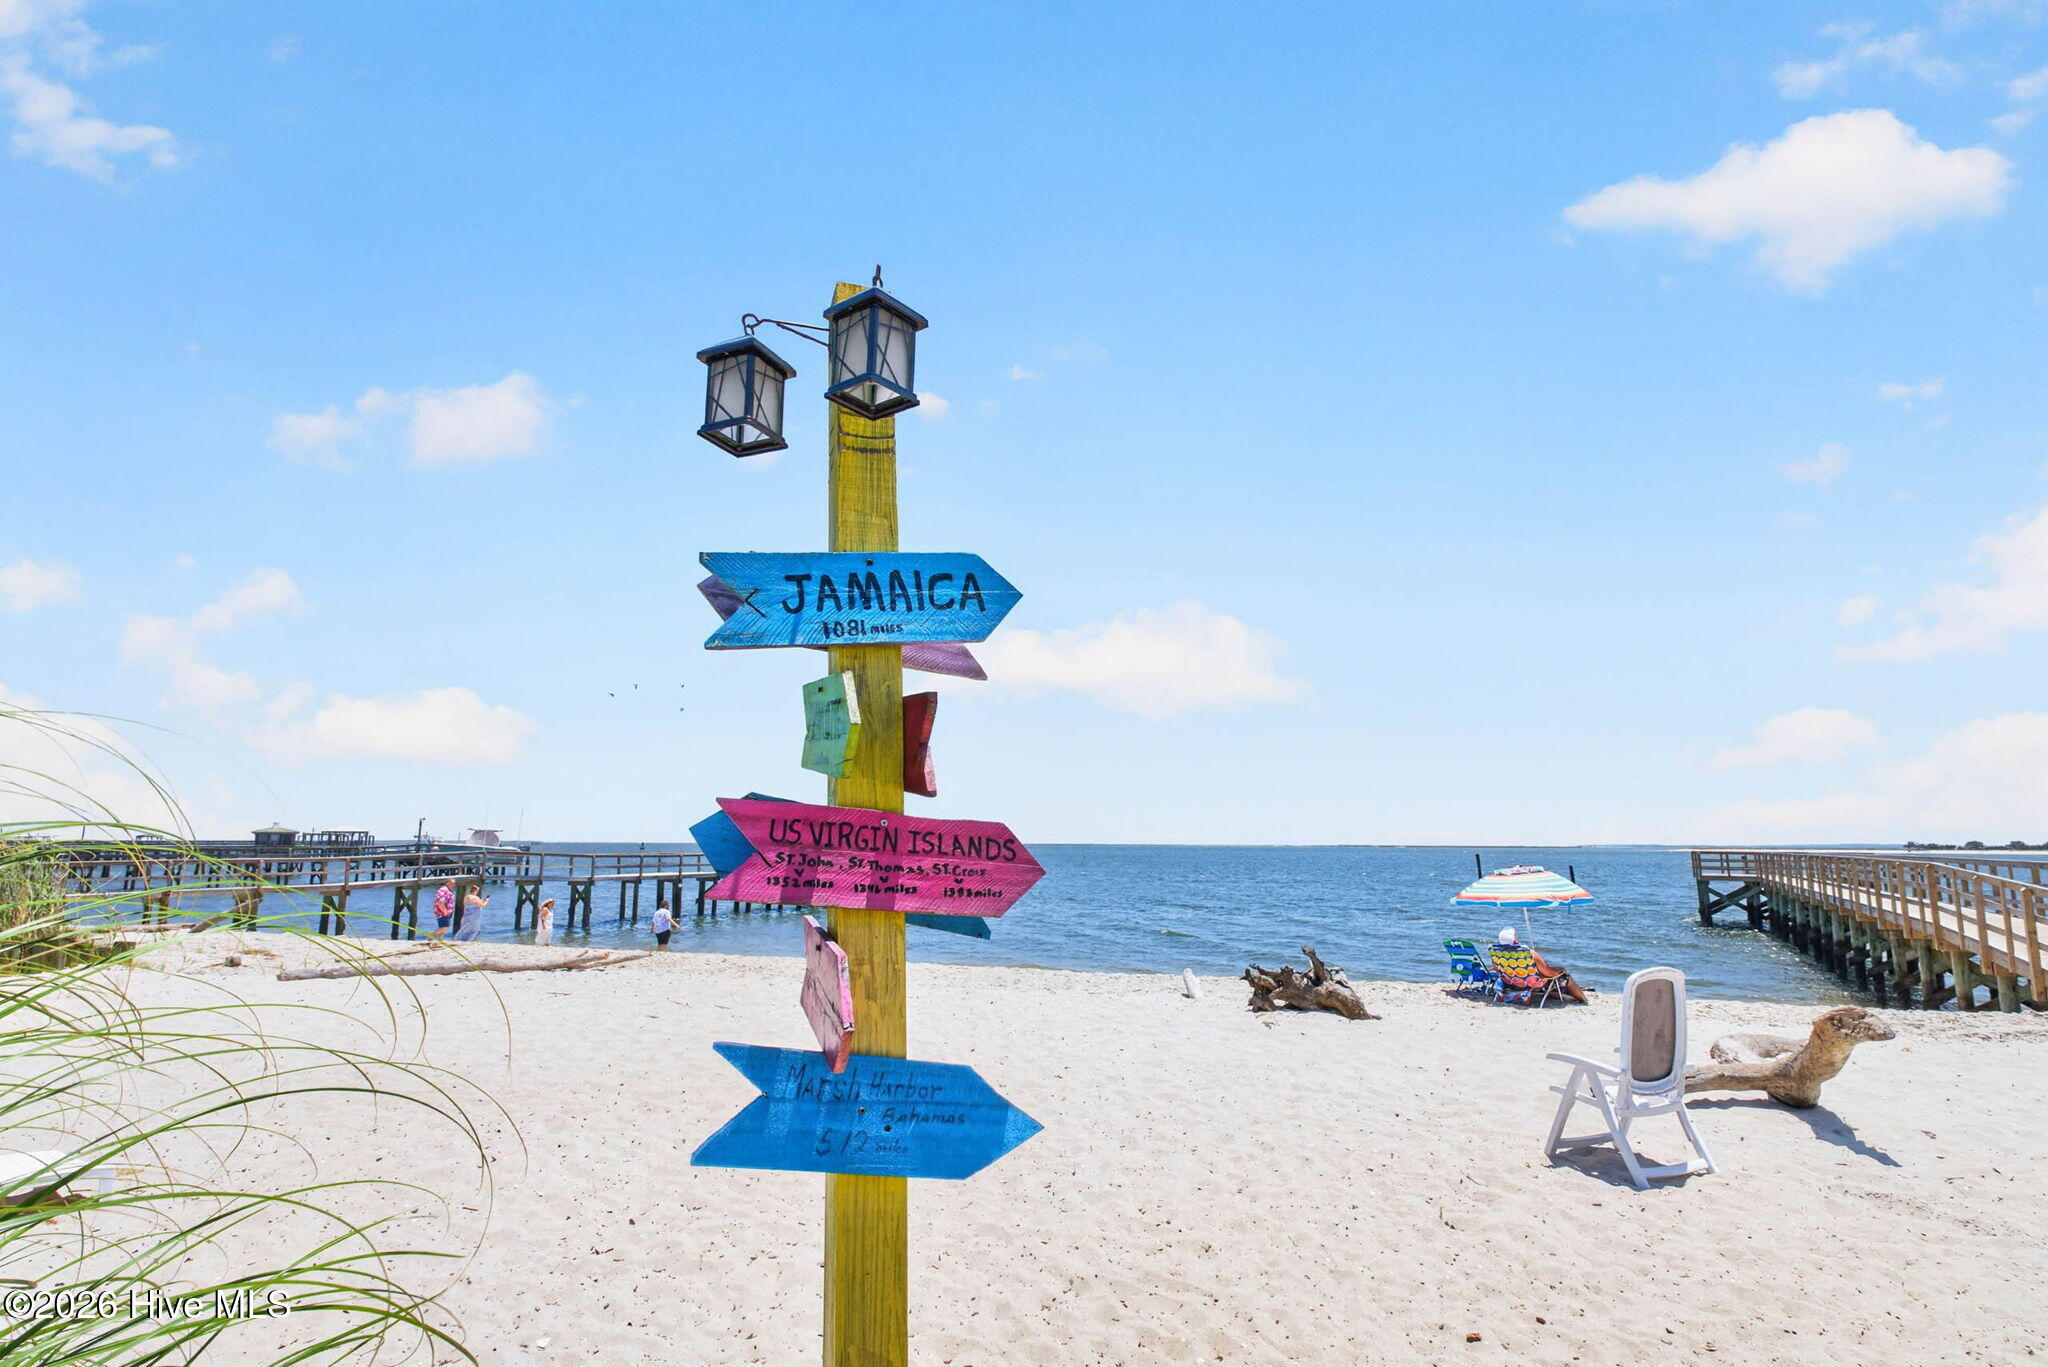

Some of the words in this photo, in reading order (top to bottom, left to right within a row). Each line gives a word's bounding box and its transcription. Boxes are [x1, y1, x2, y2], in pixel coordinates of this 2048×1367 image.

[781, 569, 986, 615] JAMAICA
[822, 619, 867, 639] 1081
[808, 822, 898, 855] VIRGIN
[908, 831, 1018, 862] ISLANDS
[880, 1106, 967, 1125] Bahamas
[814, 1127, 869, 1156] 512
